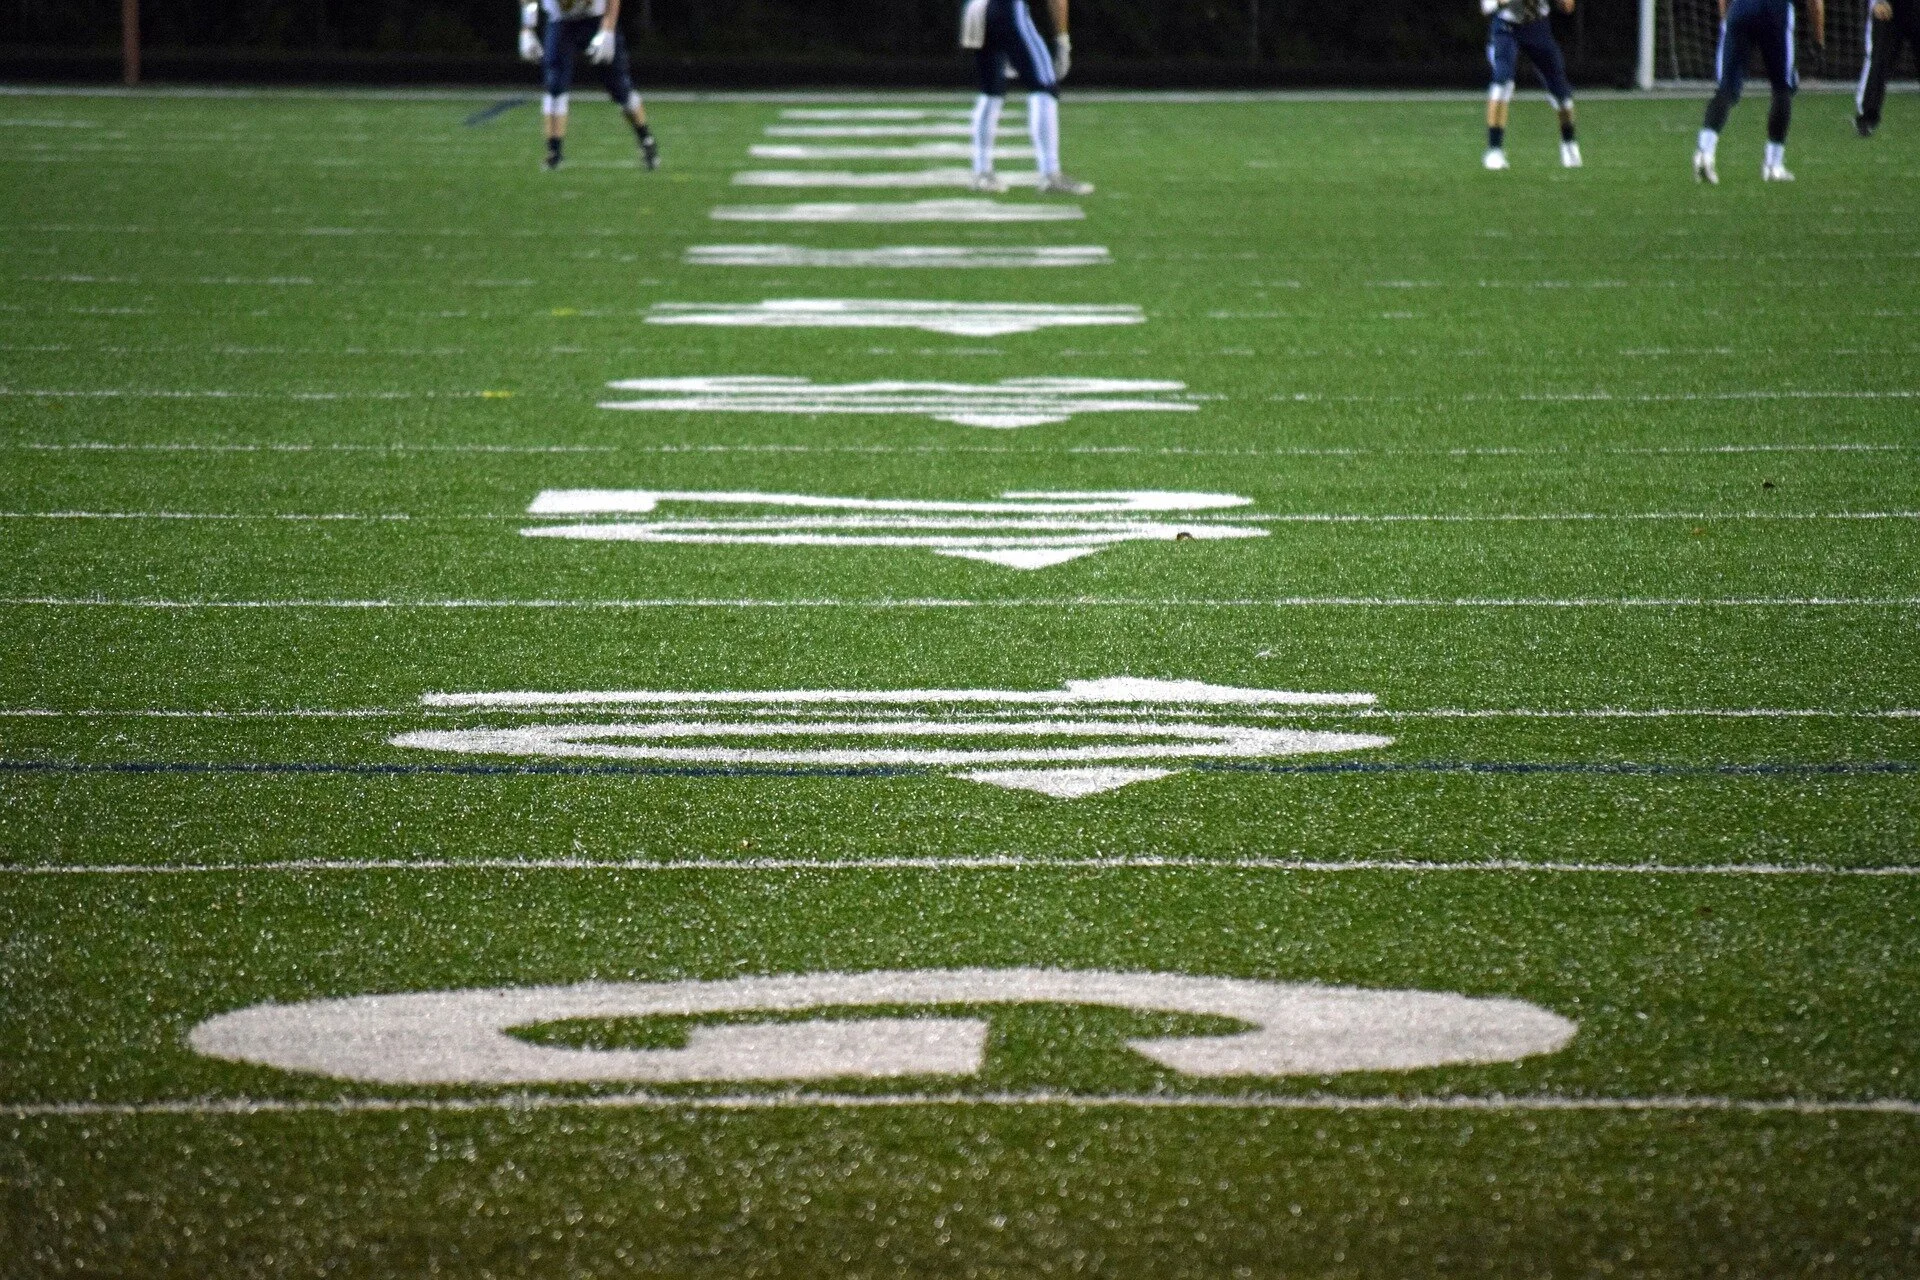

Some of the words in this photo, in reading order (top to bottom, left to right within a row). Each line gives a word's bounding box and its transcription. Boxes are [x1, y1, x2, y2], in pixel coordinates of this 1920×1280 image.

[597, 375, 1200, 412] 30
[519, 489, 1271, 546] 20
[387, 676, 1394, 764] 10
[186, 968, 1578, 1086] G
